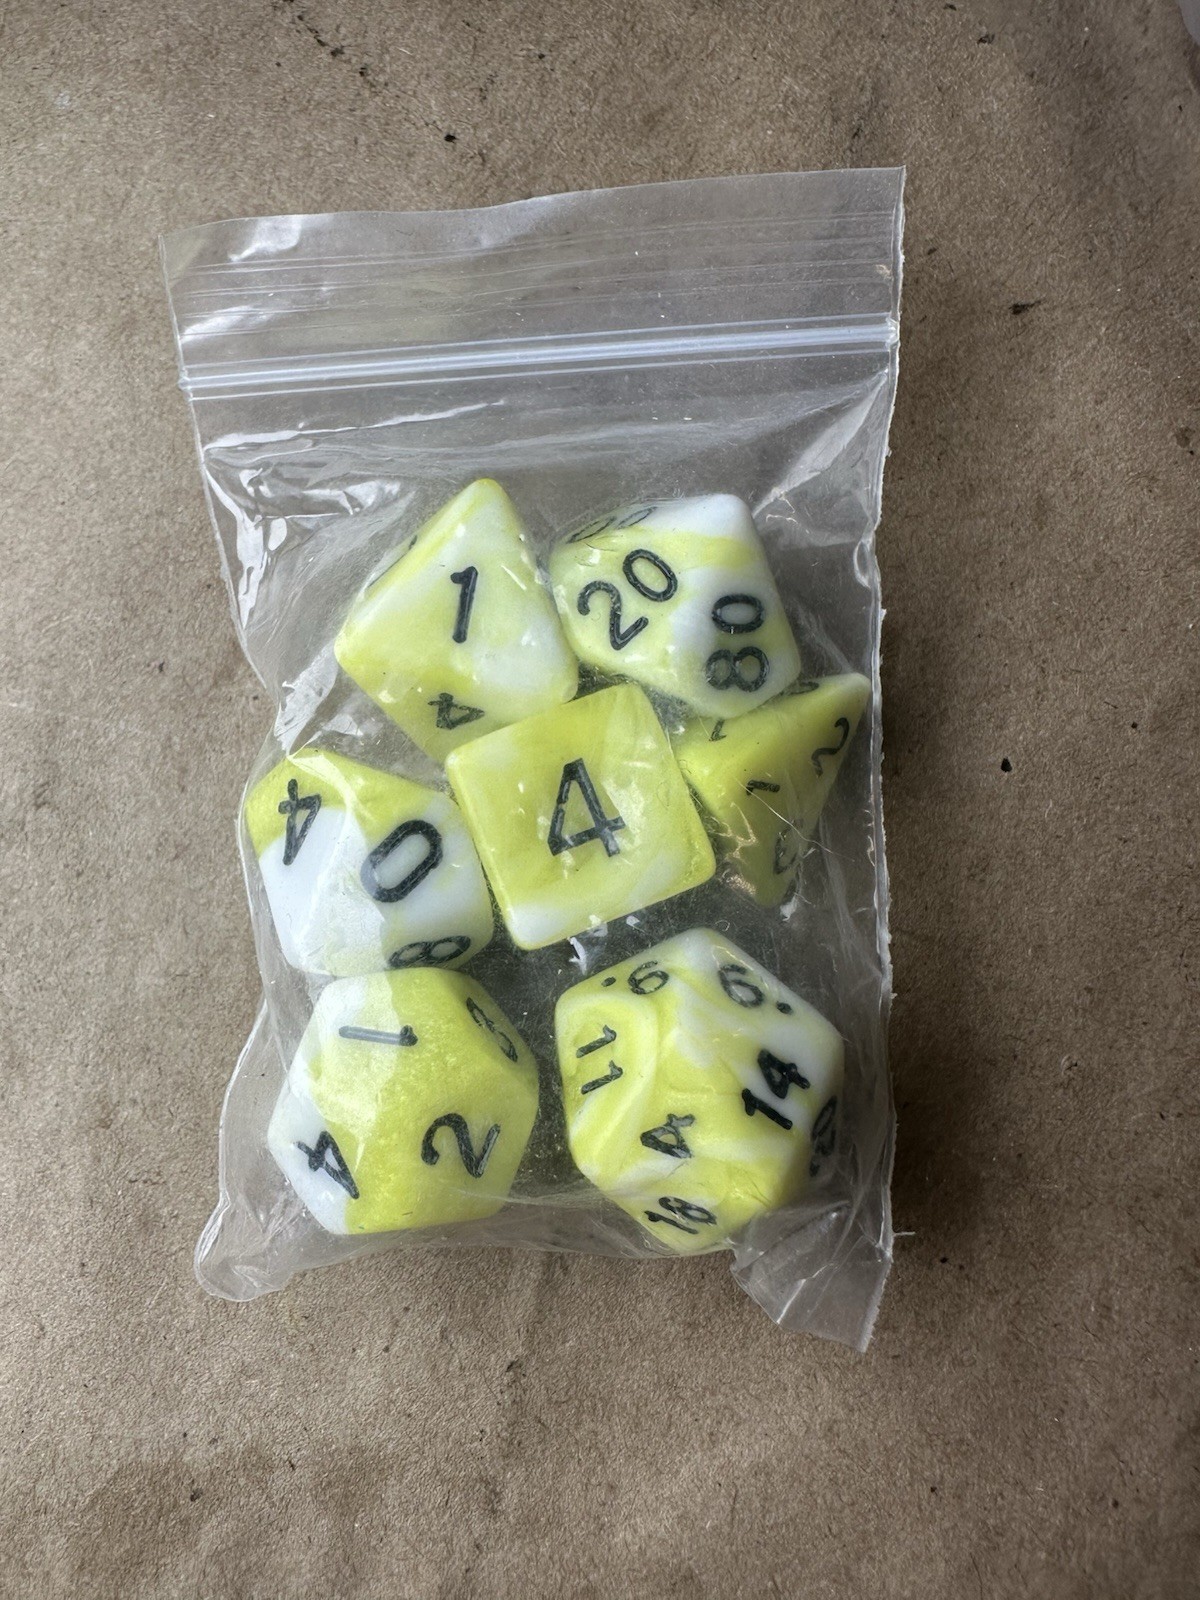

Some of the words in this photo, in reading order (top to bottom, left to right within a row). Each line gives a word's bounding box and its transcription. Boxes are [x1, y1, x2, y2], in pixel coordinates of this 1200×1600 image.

[450, 566, 478, 643] 1
[577, 549, 678, 650] 20
[705, 594, 770, 692] 80
[427, 692, 485, 730] 4
[278, 778, 322, 866] 4
[547, 758, 626, 857] 4
[360, 819, 443, 903] 0
[388, 935, 471, 968] 8
[338, 1024, 418, 1047] 1
[576, 1024, 623, 1095] 11
[741, 1048, 811, 1131] 14
[292, 1131, 360, 1200] 4
[421, 1113, 501, 1178] 2
[640, 1113, 696, 1159] 4
